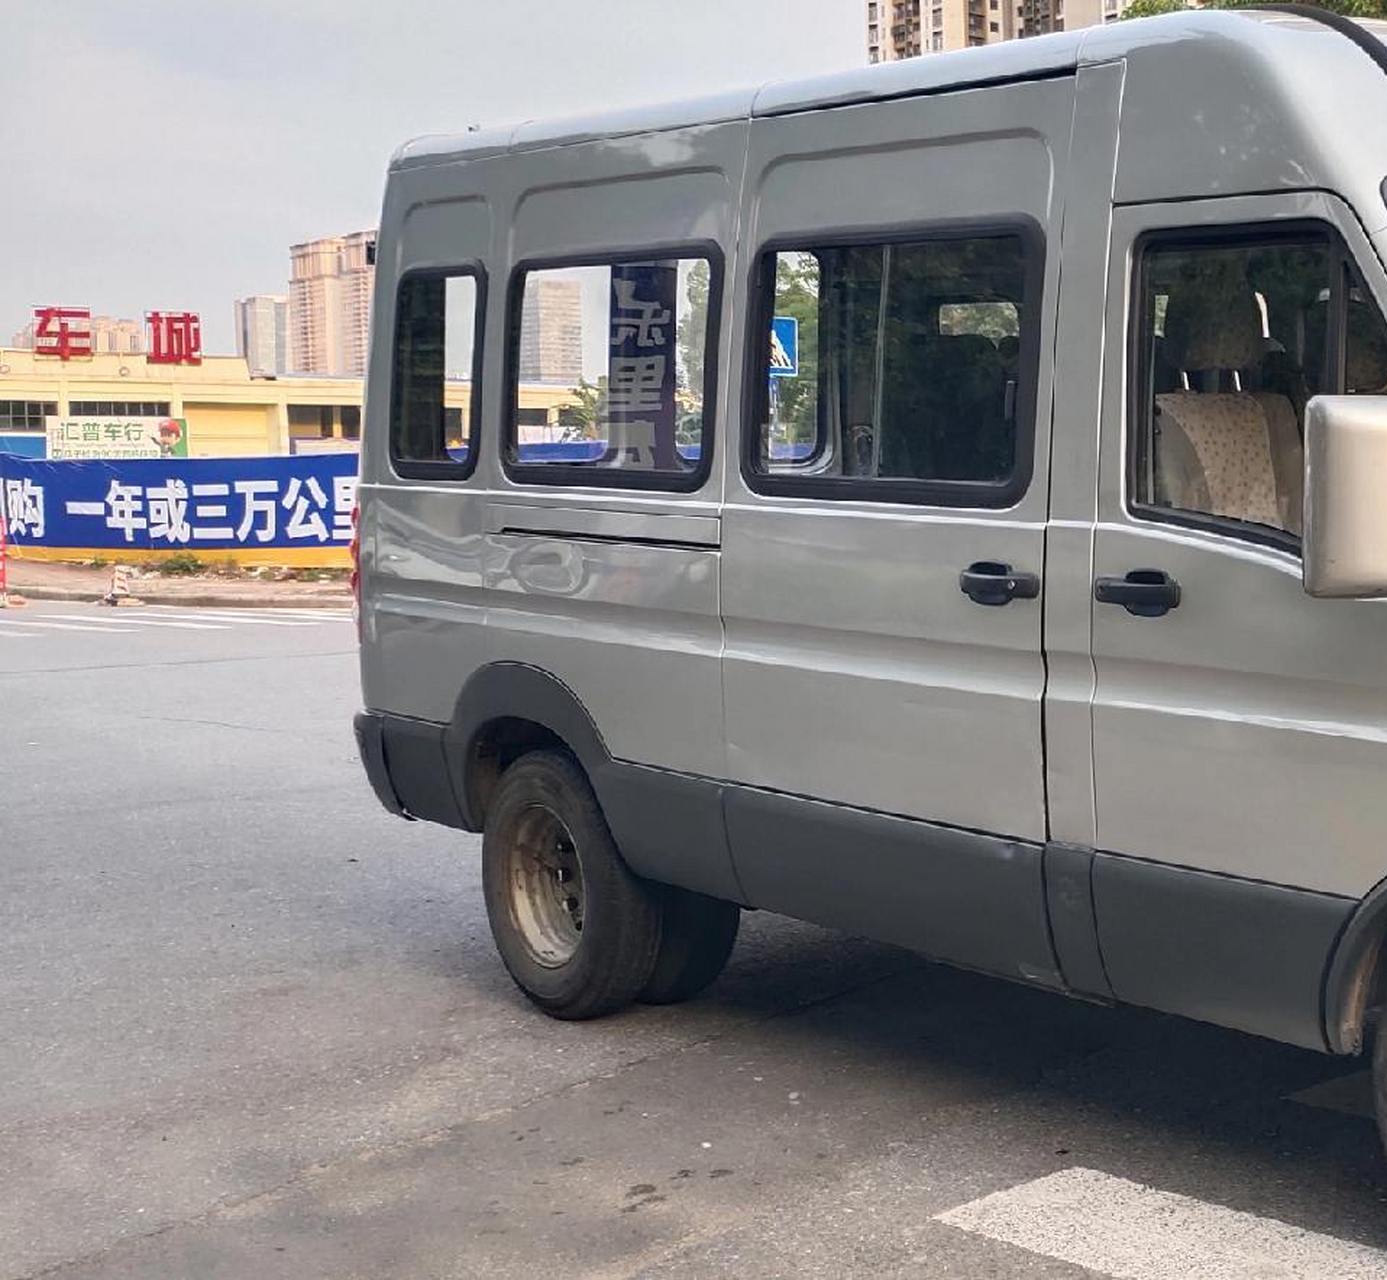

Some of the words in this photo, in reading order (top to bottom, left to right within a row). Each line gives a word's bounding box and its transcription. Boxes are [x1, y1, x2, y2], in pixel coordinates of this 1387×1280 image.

[60, 422, 144, 441] 汇普车行
[0, 477, 44, 537] 购
